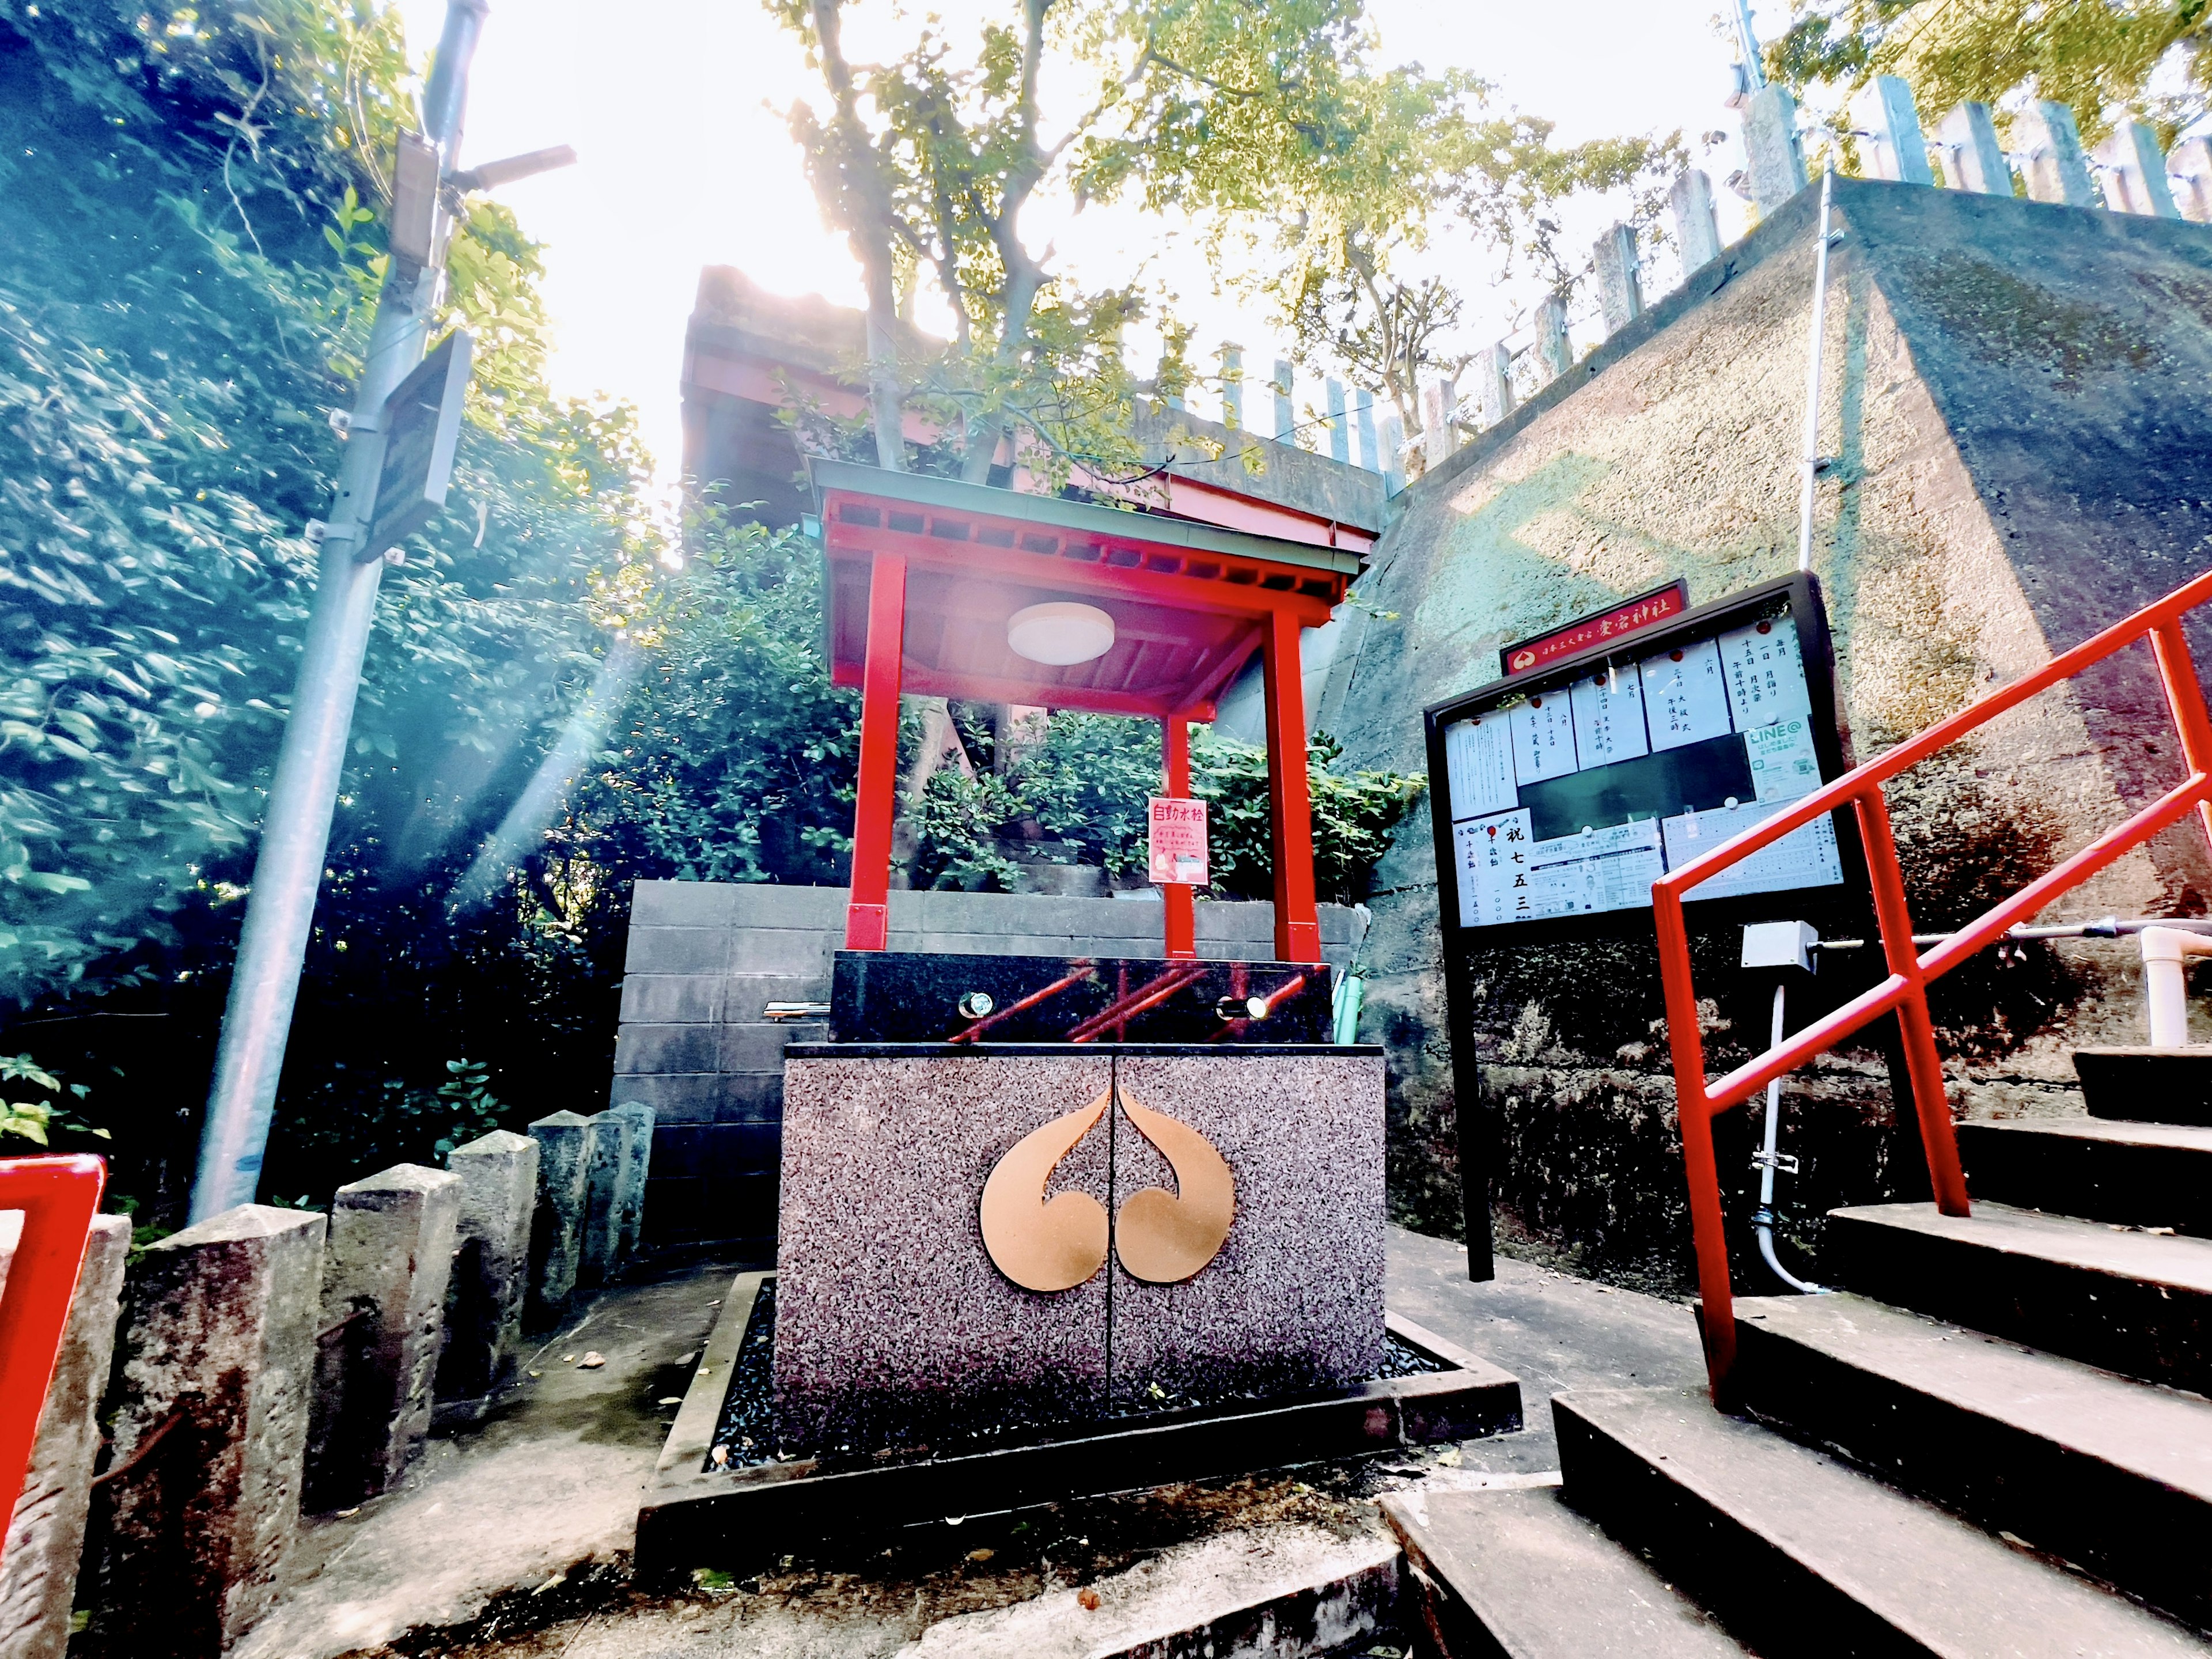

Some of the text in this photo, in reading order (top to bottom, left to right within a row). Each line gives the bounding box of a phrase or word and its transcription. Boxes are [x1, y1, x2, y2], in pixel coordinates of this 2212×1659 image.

[1597, 599, 1671, 636] 愛宕神社
[1741, 639, 1755, 665] 十五日
[1760, 645, 1770, 660] 一日
[1776, 639, 1786, 657] 毎月
[1673, 668, 1683, 687] 三十日
[1705, 659, 1714, 675] 六月
[1733, 662, 1749, 714] 午前十時より
[1668, 698, 1679, 730] 午後三時
[1750, 721, 1801, 744] LINE@
[1154, 804, 1203, 821] 自動水栓
[1506, 828, 1530, 910] 祝七五三
